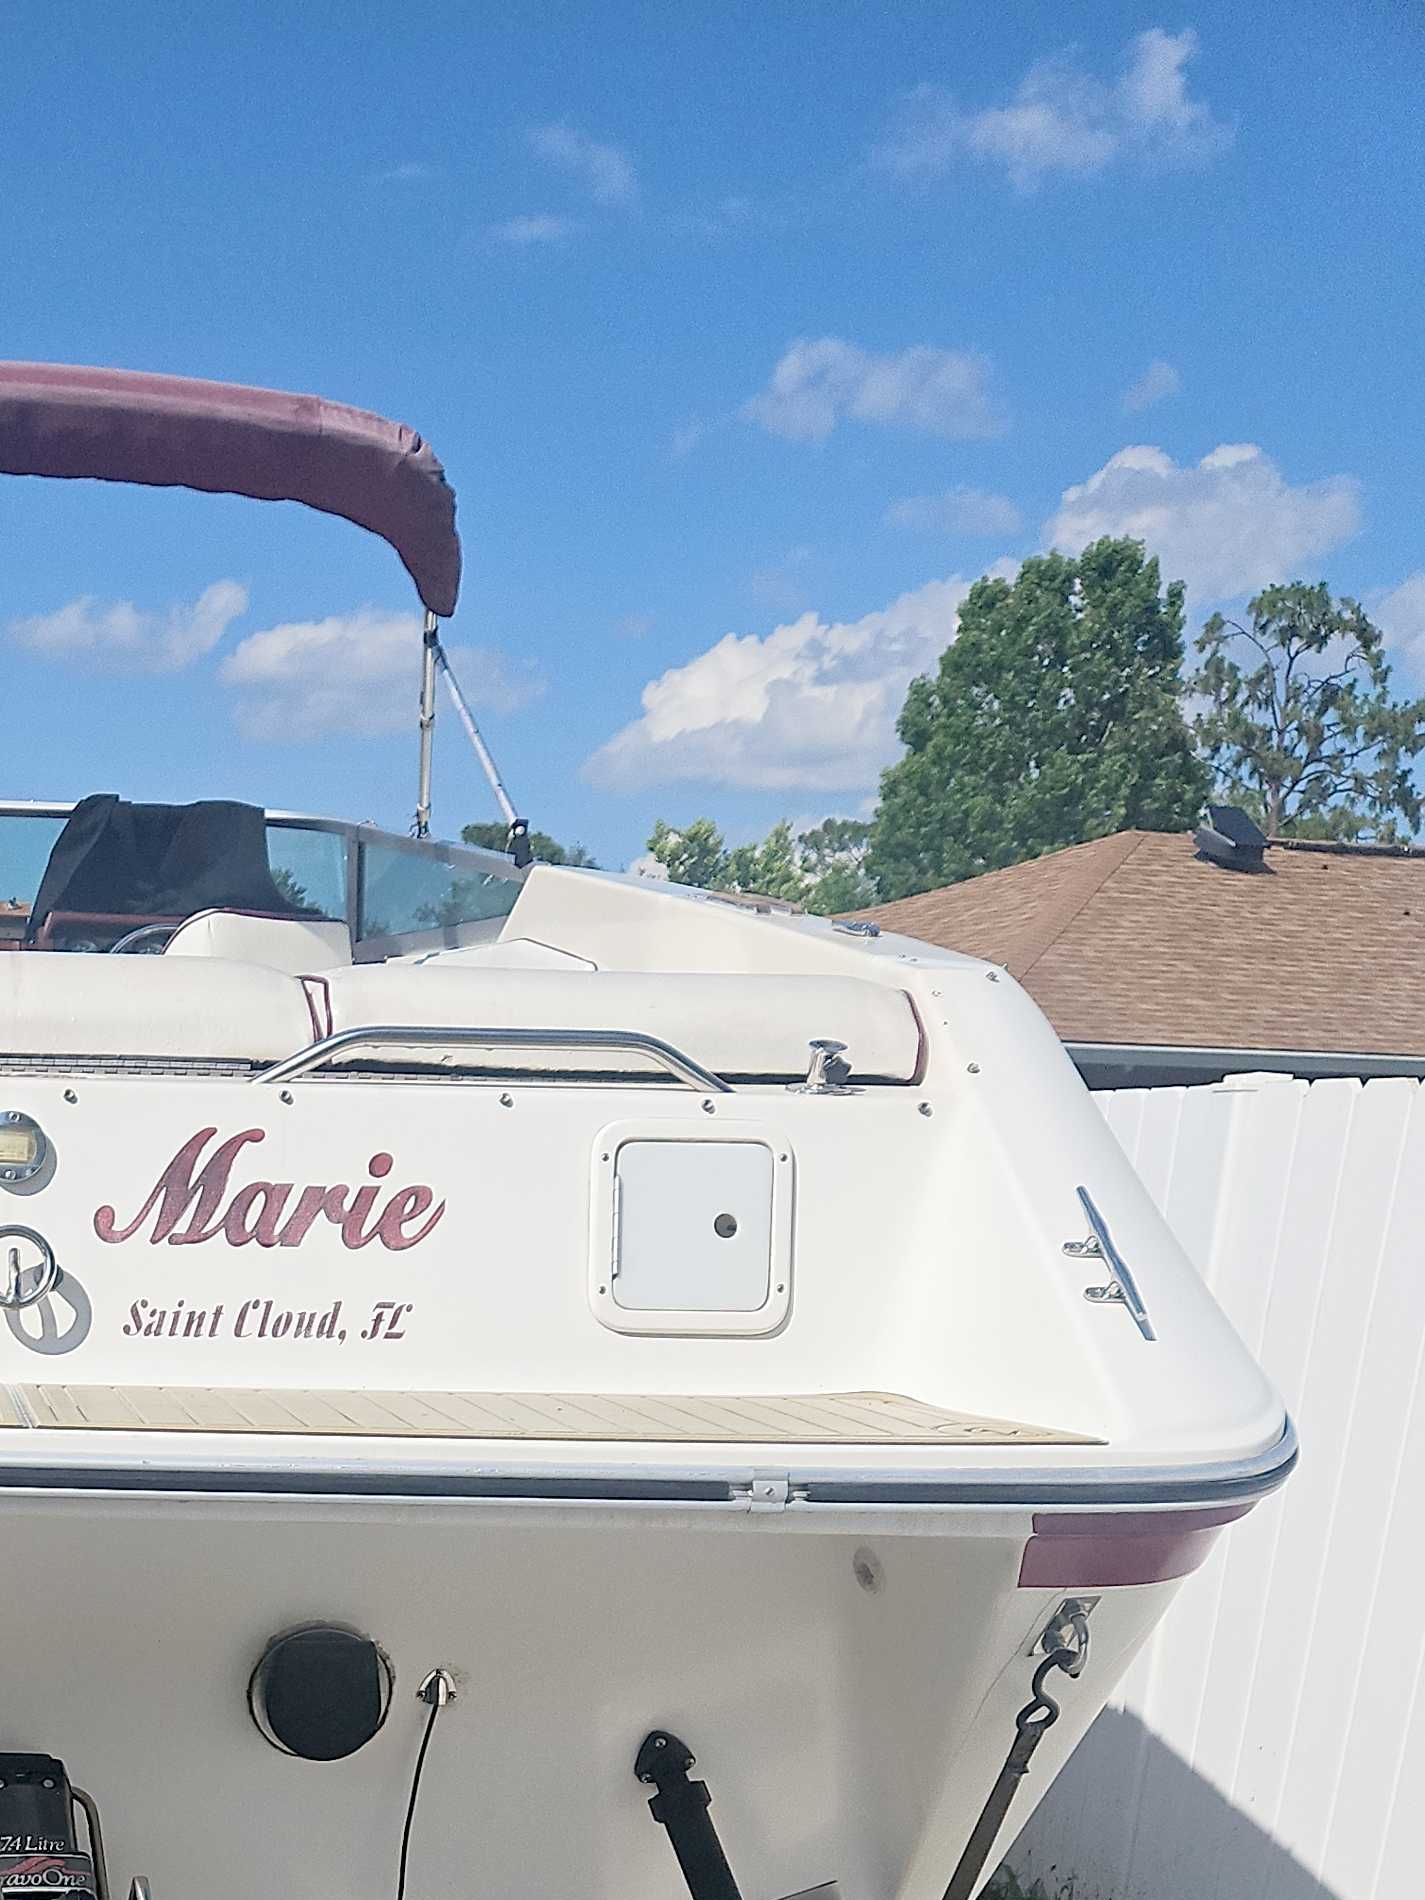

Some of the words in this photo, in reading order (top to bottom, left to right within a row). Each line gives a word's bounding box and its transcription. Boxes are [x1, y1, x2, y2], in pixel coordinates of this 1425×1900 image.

[94, 1127, 446, 1251] Marie
[122, 1299, 224, 1338] Saint
[233, 1299, 347, 1345] Cloud,
[361, 1302, 414, 1340] FL
[24, 1835, 65, 1852] Litre
